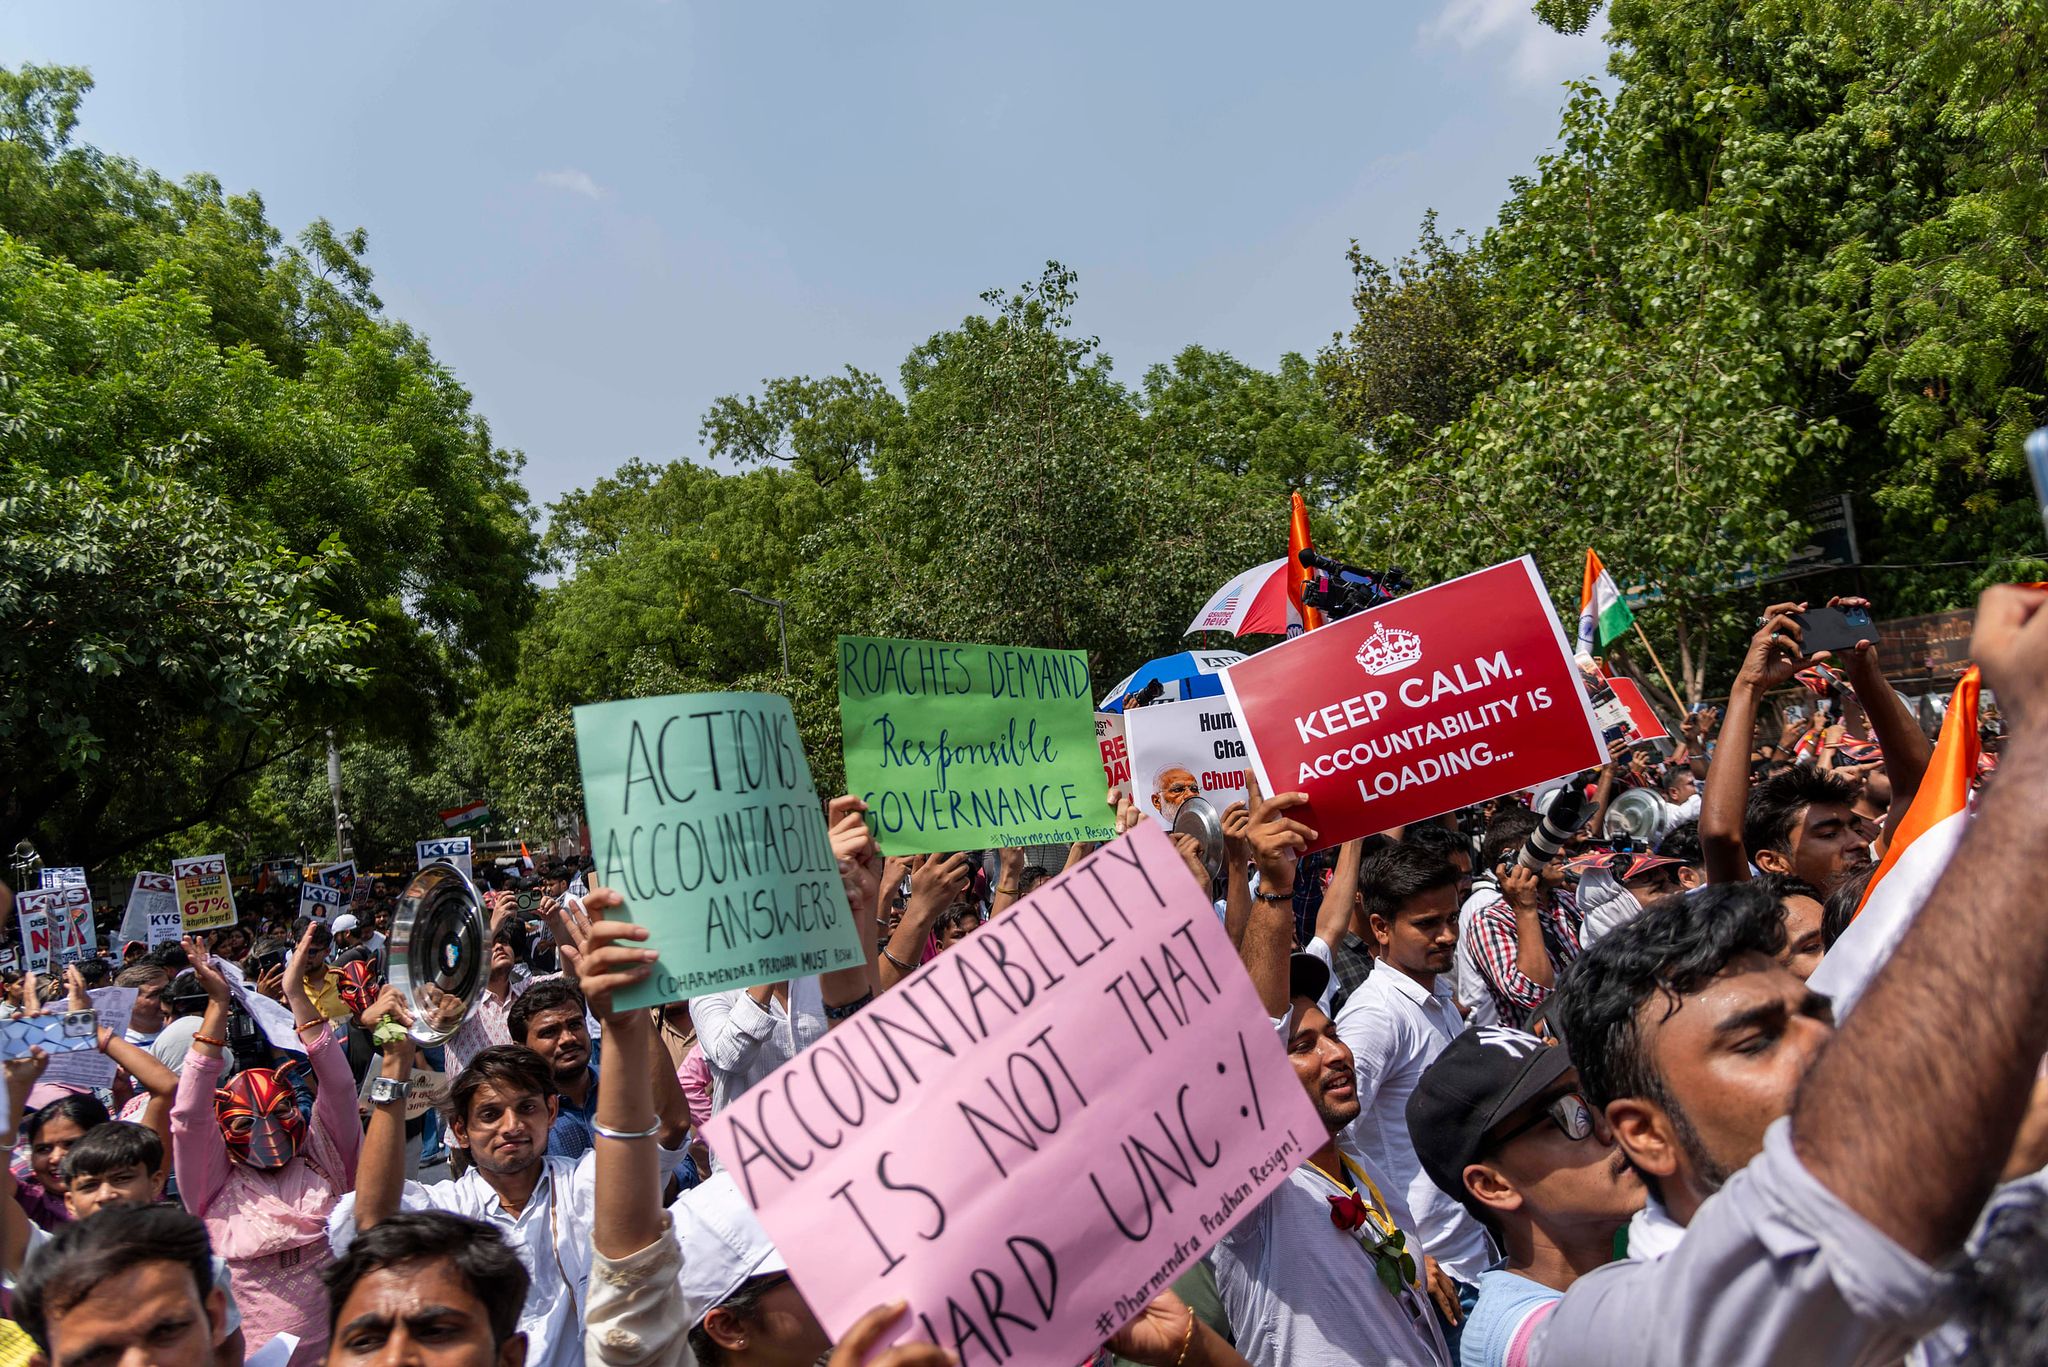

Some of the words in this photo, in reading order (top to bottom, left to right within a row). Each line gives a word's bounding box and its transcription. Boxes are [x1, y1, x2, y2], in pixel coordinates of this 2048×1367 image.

[1203, 617, 1231, 627] news
[843, 642, 971, 696] ROACHES
[988, 651, 1090, 700] DEMAND
[1294, 690, 1388, 744] KEEP
[1399, 650, 1523, 708] CALM.
[624, 709, 797, 815] ACTIONS
[873, 713, 1057, 793] Responsible
[1298, 695, 1519, 784] ACCOUNTABILITY
[1526, 687, 1553, 712] IS
[1357, 742, 1514, 802] LOADING...
[863, 784, 1082, 838] GOVERNANCE
[179, 861, 223, 877] KYS
[423, 841, 466, 857] KYS
[151, 914, 180, 926] KYS
[184, 896, 229, 916] 67%
[305, 887, 338, 903] KYS
[707, 881, 842, 953] ANSWERS.
[801, 949, 828, 972] MUST
[729, 835, 1166, 1210] ACCOUNTABILITY
[830, 1151, 946, 1277] IS
[957, 1025, 1088, 1179] NOT
[1104, 919, 1221, 1053] THAT
[1090, 1084, 1220, 1242] UNC
[1199, 1181, 1253, 1235] Pradhan
[1248, 1129, 1303, 1187] Resign!
